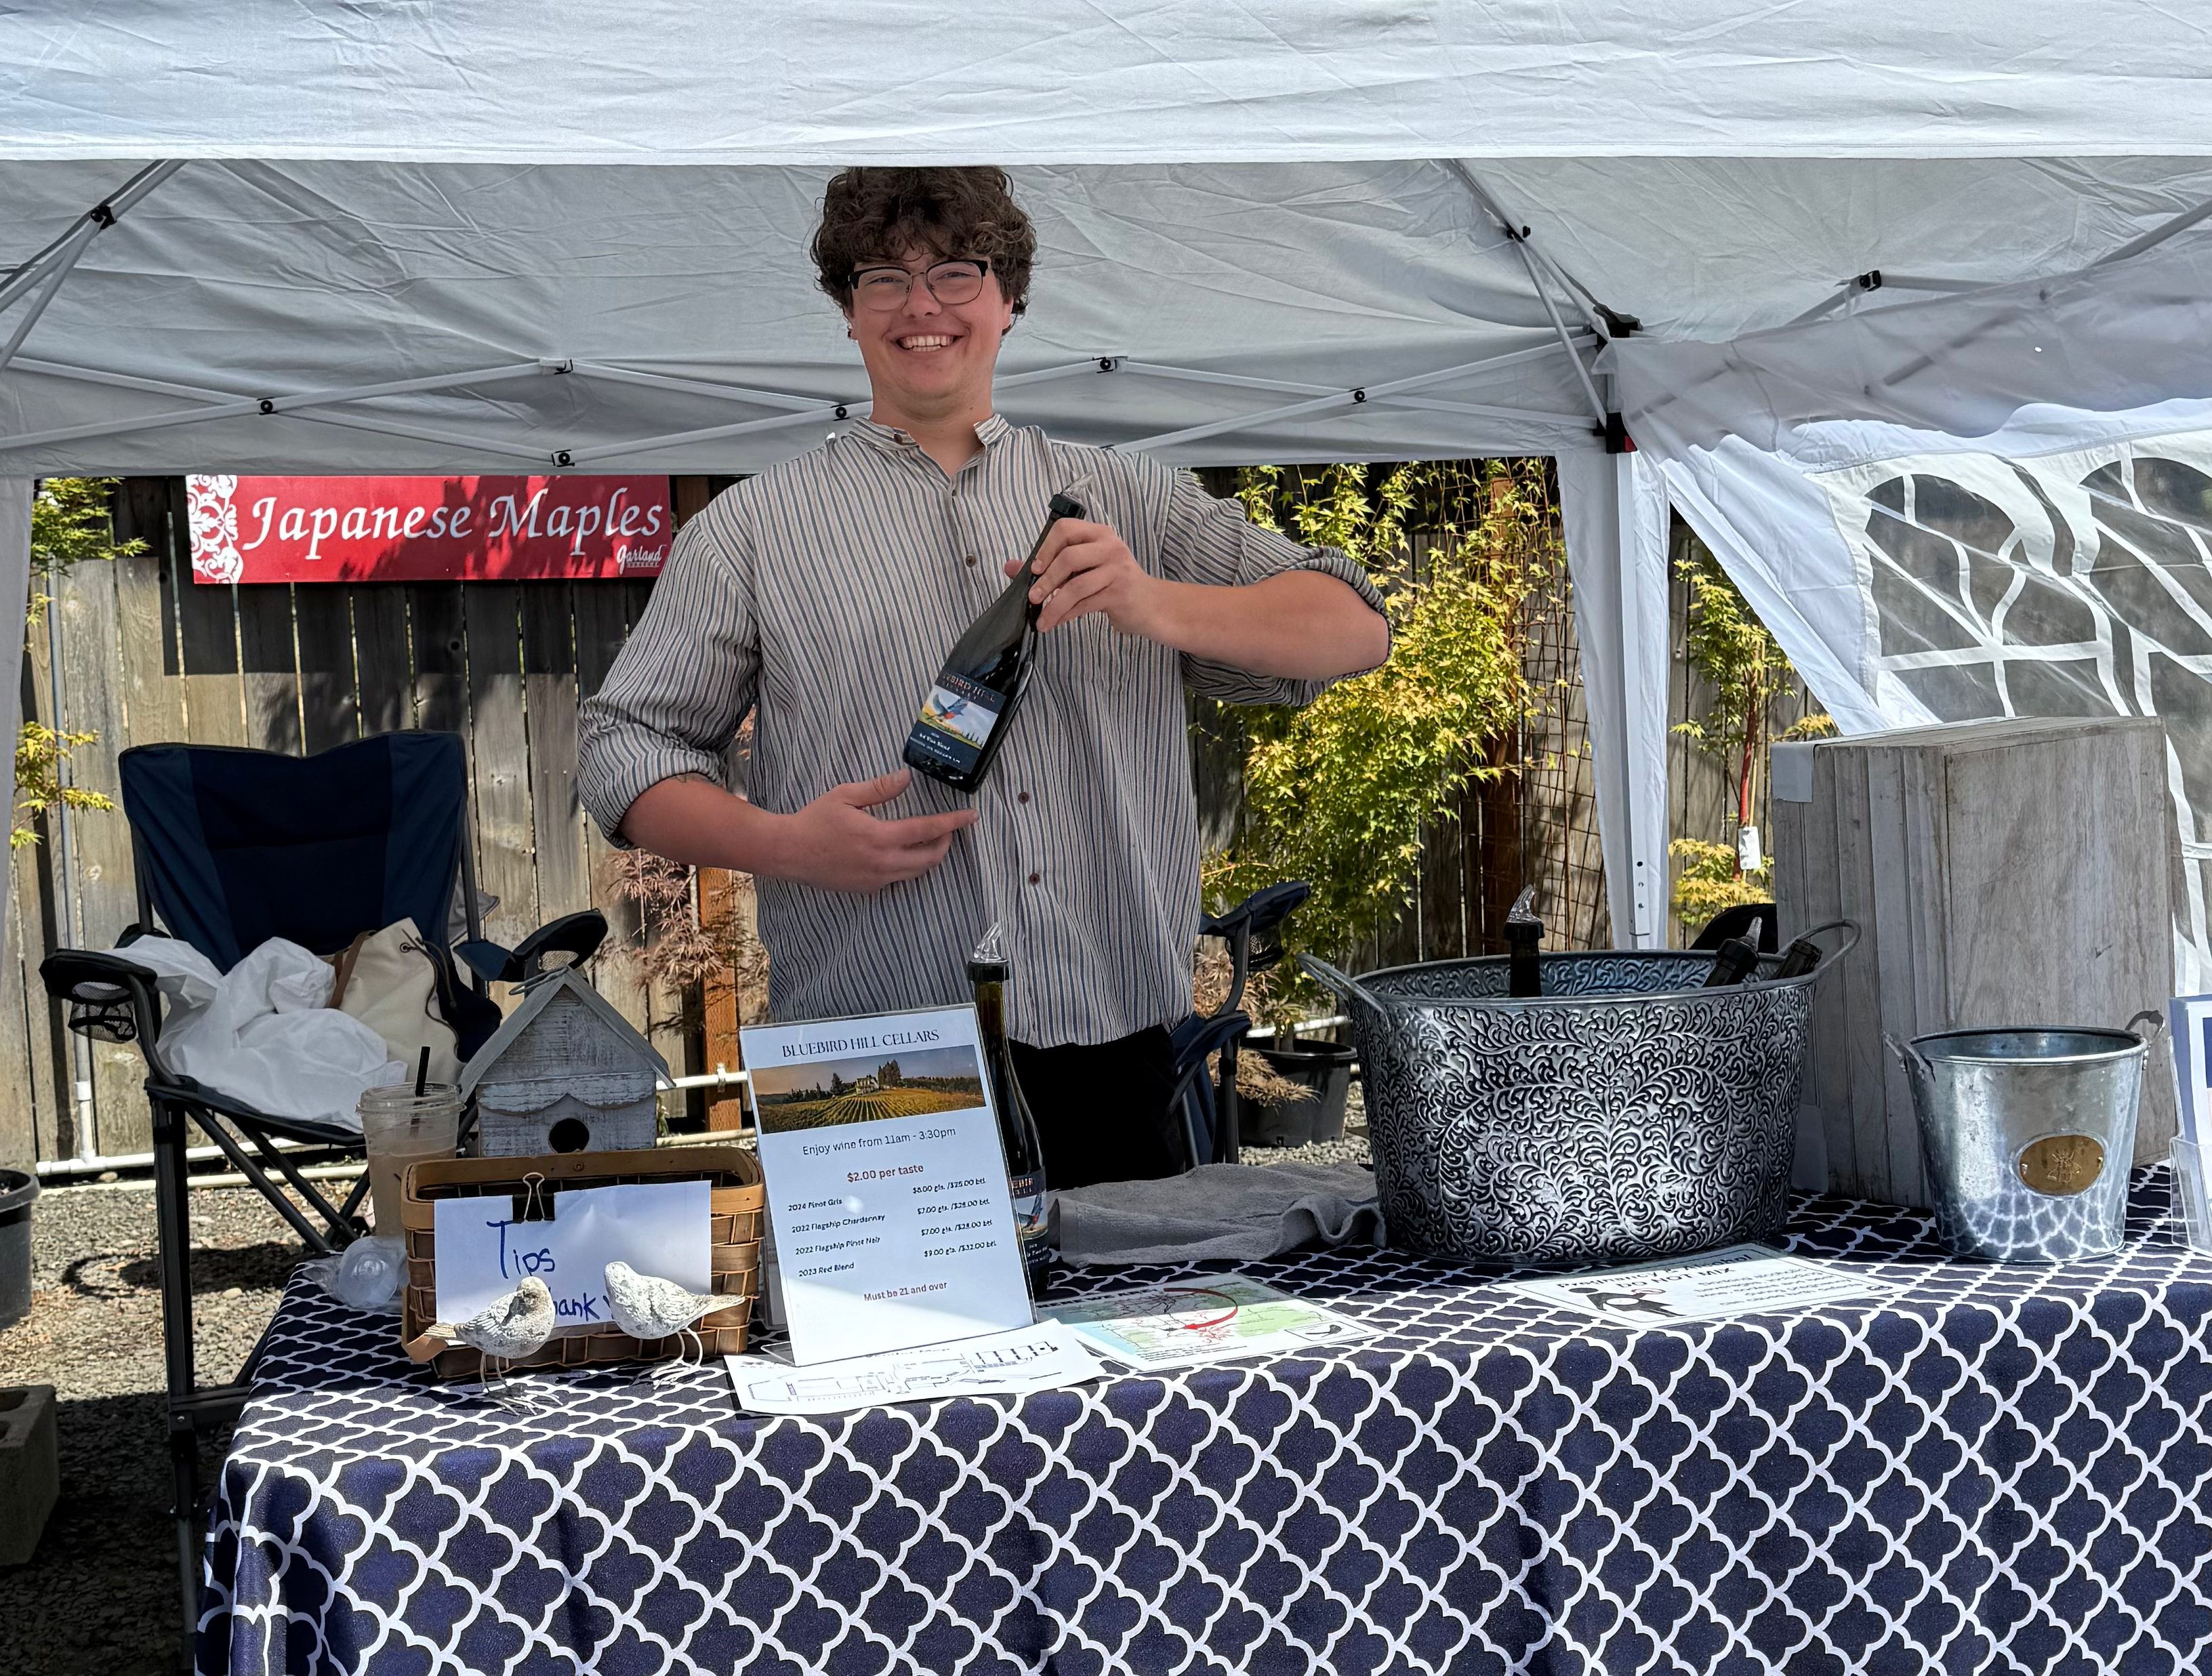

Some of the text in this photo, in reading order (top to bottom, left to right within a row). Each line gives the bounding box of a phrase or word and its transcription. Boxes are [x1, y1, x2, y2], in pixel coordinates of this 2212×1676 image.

[243, 489, 663, 560] Japanese Maples
[781, 1029, 940, 1057] BLUEBIRD HILL CELLARS
[803, 1144, 831, 1156] Enjoy
[833, 1141, 856, 1151] wine
[859, 1137, 883, 1148] from
[885, 1133, 911, 1145] 11am
[919, 1128, 956, 1140] 3:30pm
[847, 1164, 924, 1183] $2.00 per taste
[788, 1198, 842, 1212] 2024 Pinot Gris
[917, 1206, 937, 1215] $7.00
[791, 1214, 886, 1233] 2022 Flagship Chardonnay
[921, 1227, 940, 1236] $7.00
[486, 1220, 556, 1280] Tips
[795, 1235, 881, 1255] 2022 Flagship Pinot Noir
[924, 1248, 943, 1257] $9.00
[798, 1261, 855, 1277] 2023 Red Blend
[1656, 1273, 1694, 1284] NOT
[1698, 1267, 1736, 1276] MIX
[863, 1282, 947, 1302] Must be 21 and over
